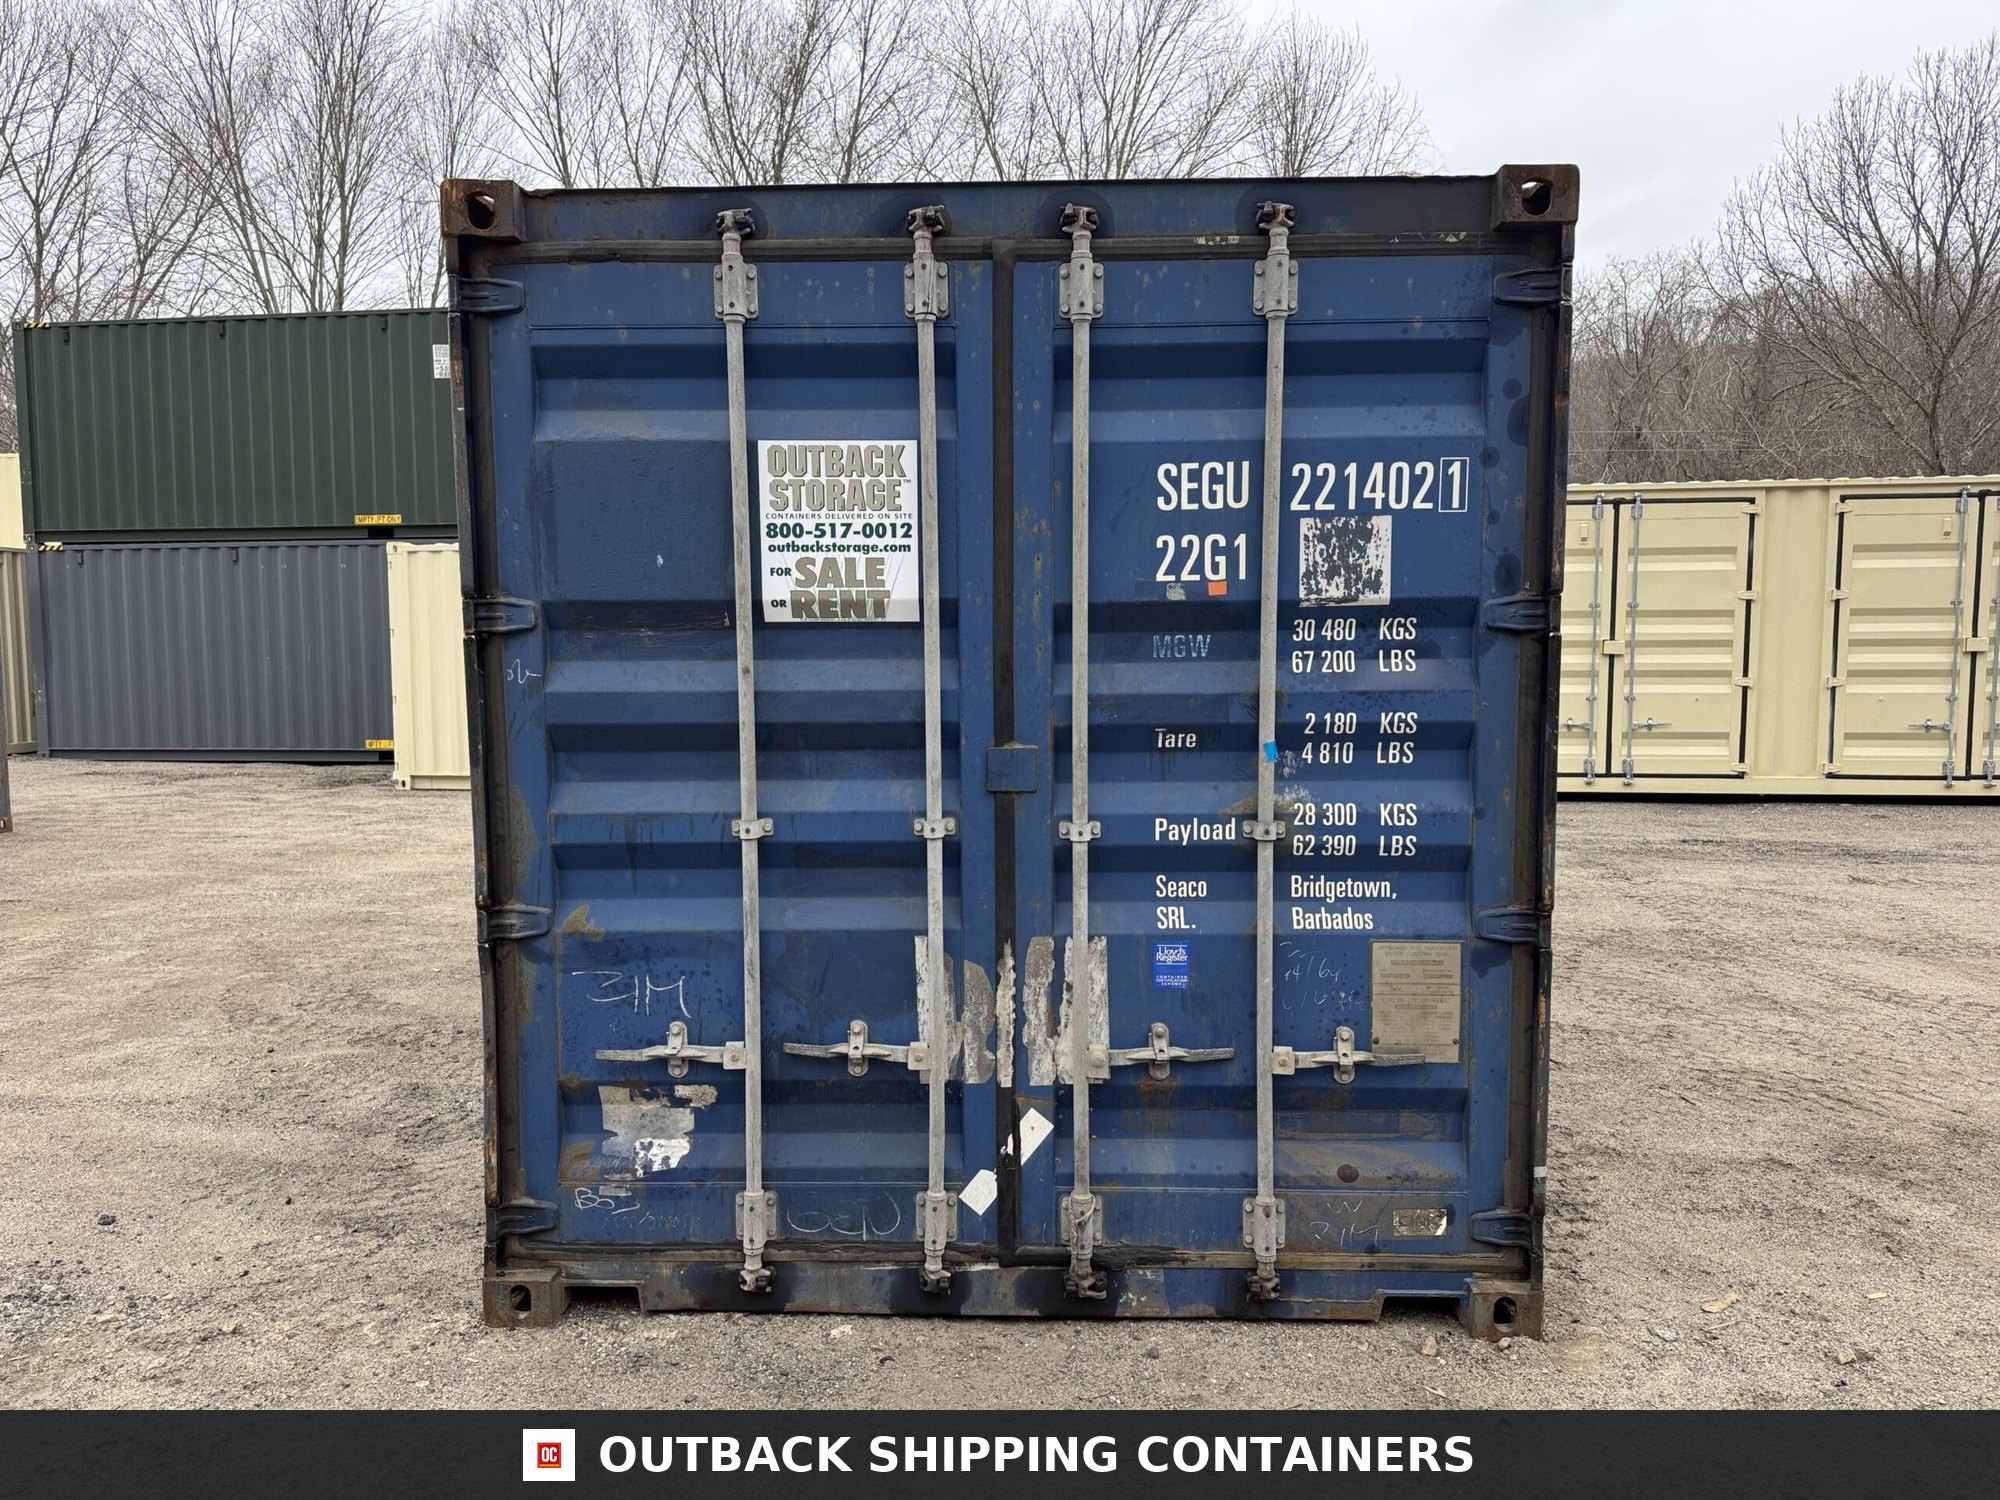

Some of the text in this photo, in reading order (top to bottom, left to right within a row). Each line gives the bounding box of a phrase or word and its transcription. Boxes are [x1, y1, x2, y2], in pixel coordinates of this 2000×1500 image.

[767, 445, 906, 477] OUTBACK
[769, 479, 902, 512] STORAGE
[1157, 460, 1250, 511] SEGU
[765, 522, 913, 539] 800-517-0012
[768, 540, 911, 555] outbackstorage.com
[1156, 533, 1247, 582] 22G1
[770, 557, 886, 589] FOR SALE
[771, 590, 891, 619] OR RENT
[1152, 617, 1417, 658] MGW 30 480 KGS
[1292, 649, 1417, 673] 67 200 LBS
[1155, 712, 1418, 749] Tare 2 180 KGS
[1301, 742, 1414, 764] 4 810 LBS
[1154, 803, 1418, 845] Payload 28 300 KGS
[1292, 835, 1417, 857] 62 390 LBS
[1155, 874, 1208, 898] Seaco
[1291, 875, 1397, 903] Bridgetown,
[1156, 906, 1197, 929] SRL.
[1292, 907, 1374, 930] Barbados
[1156, 952, 1188, 964] Register
